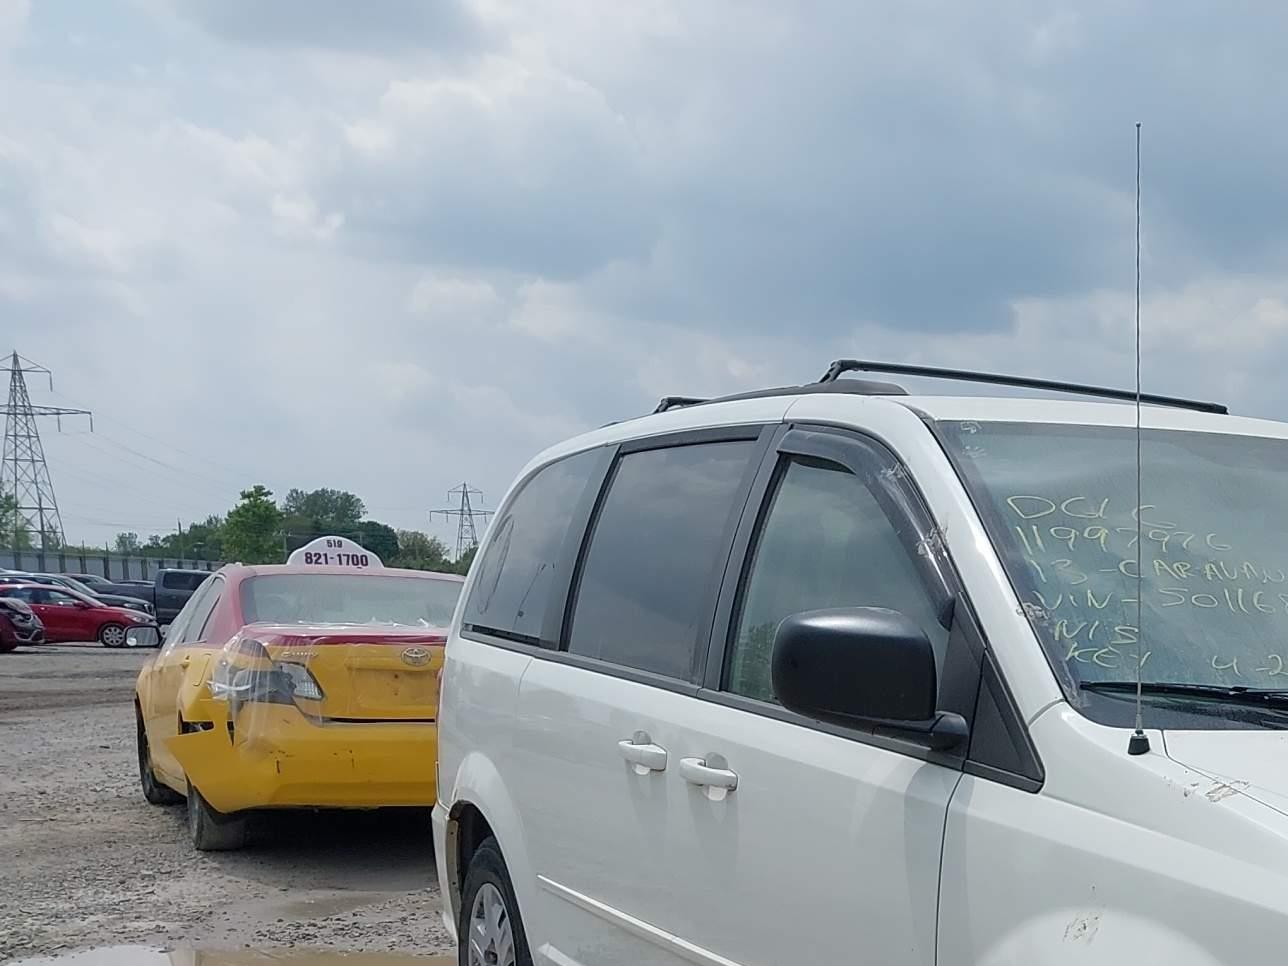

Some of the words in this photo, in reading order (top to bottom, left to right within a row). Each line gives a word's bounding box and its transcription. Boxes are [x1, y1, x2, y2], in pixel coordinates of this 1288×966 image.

[326, 539, 343, 548] 519
[1014, 525, 1232, 554] 11997976
[304, 551, 369, 567] 821-1700
